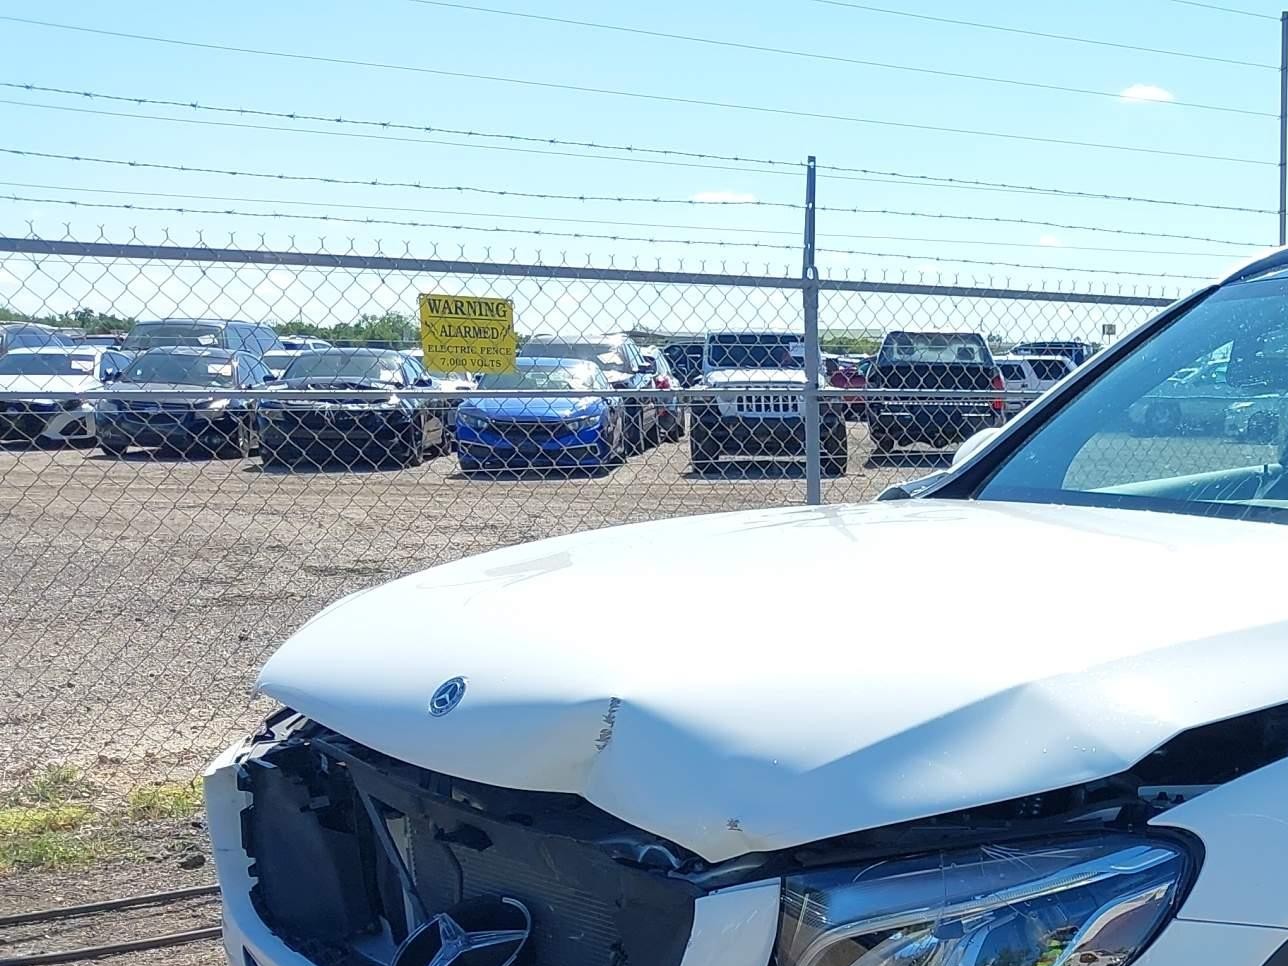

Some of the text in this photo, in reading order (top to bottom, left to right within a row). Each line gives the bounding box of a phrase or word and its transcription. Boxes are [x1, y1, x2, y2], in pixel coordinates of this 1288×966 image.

[428, 299, 507, 318] WARNING
[440, 325, 499, 340] ALARMED
[428, 345, 512, 356] ELECTRIC FENCE
[440, 358, 502, 368] 7,000 VOLTS
